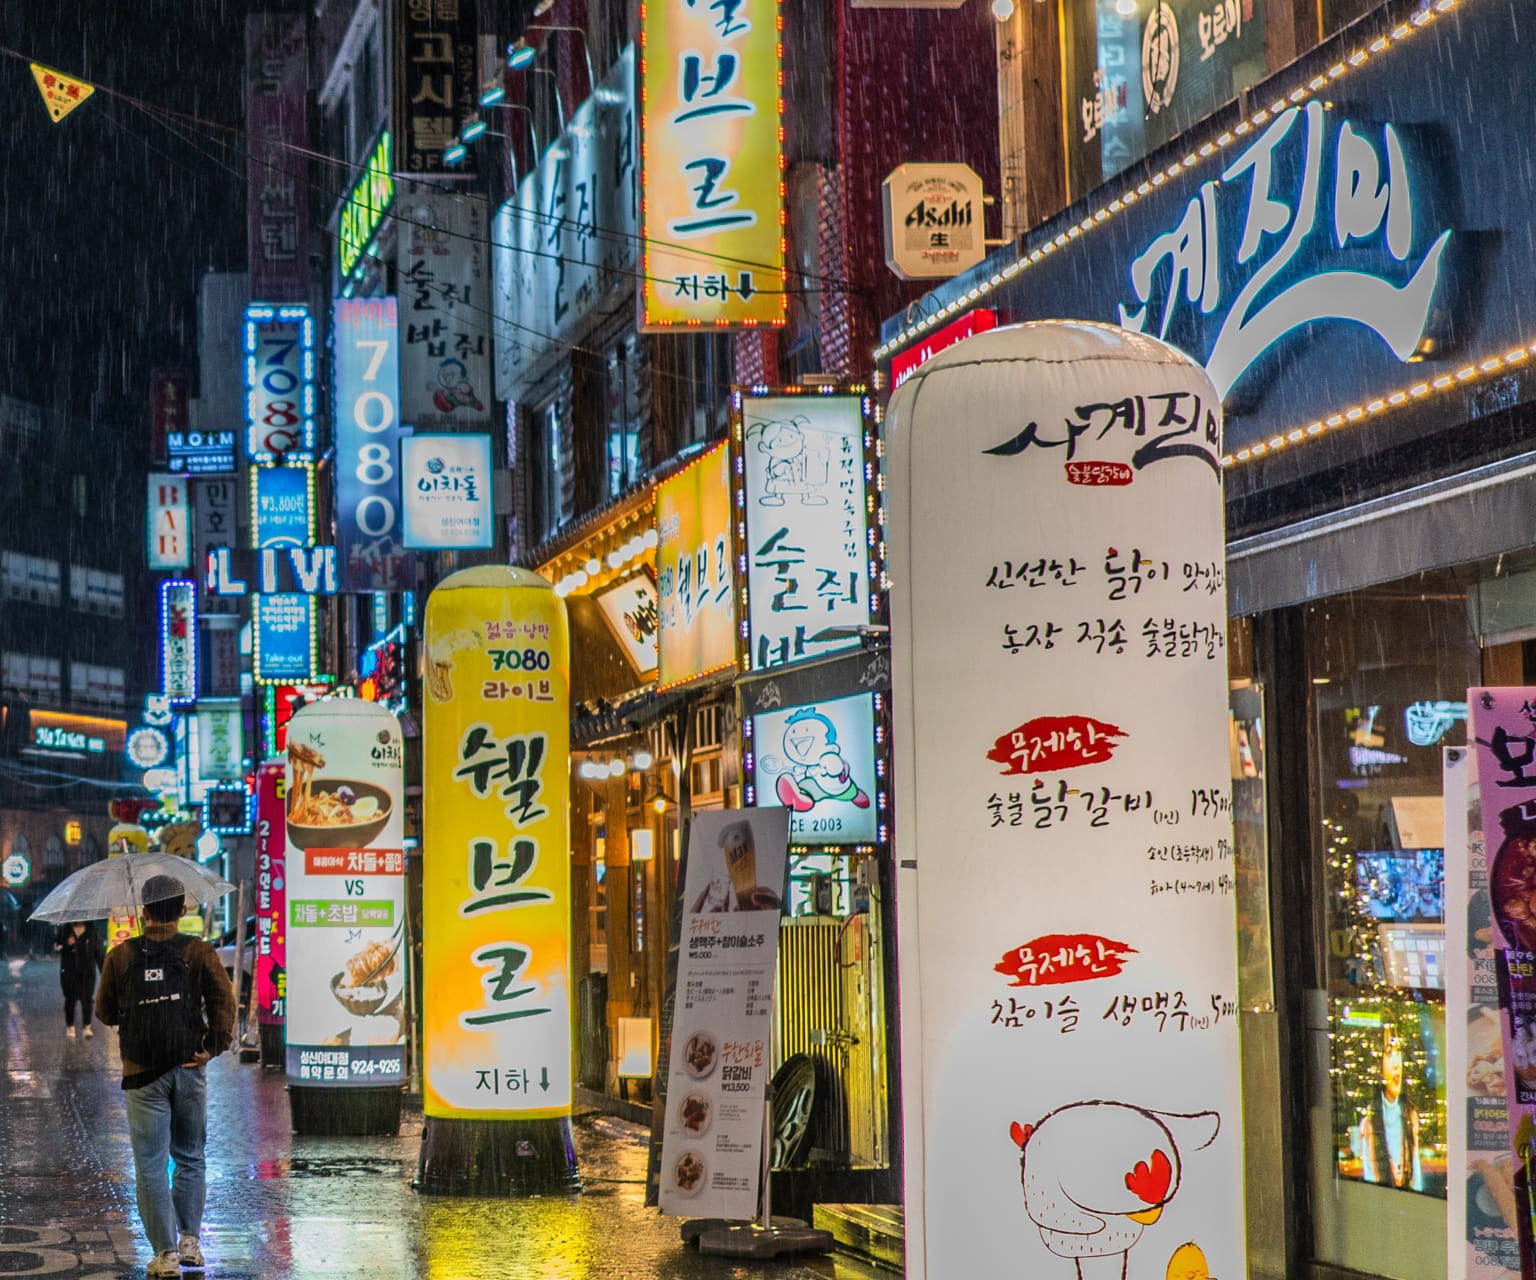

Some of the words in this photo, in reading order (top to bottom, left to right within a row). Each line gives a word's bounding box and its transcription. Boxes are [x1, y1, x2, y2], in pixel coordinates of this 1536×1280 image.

[904, 199, 973, 229] Asahi
[930, 232, 949, 247] 生
[673, 272, 730, 302] 지하
[263, 338, 299, 455] 7080
[353, 340, 395, 537] 7080
[417, 475, 480, 502] 이차돌
[1068, 464, 1131, 485] 숯불닭갈비
[677, 540, 730, 628] 쉘브르
[984, 557, 1088, 590] 신선한
[1104, 547, 1170, 601] 닭이
[1001, 623, 1064, 654] 농장
[1076, 619, 1129, 654] 직송
[265, 654, 285, 663] Take
[287, 654, 304, 663] out
[487, 649, 551, 672] 7080
[482, 679, 556, 702] 라이브
[1008, 723, 1108, 771] 무제한
[986, 779, 1154, 829] 숯불닭갈비
[1153, 809, 1180, 826] (1인)
[813, 818, 843, 833] 2003
[1147, 845, 1168, 862] 소인
[344, 879, 365, 897] VS
[456, 727, 552, 1025] 쉘브르
[1150, 879, 1173, 895] 유아
[1017, 942, 1115, 986] 무제한
[990, 994, 1081, 1034] 참이슬
[1102, 990, 1190, 1033] 생맥주
[299, 1050, 349, 1066] 성신여대점
[351, 1057, 401, 1076] 924-9295
[474, 1067, 530, 1096] 지하
